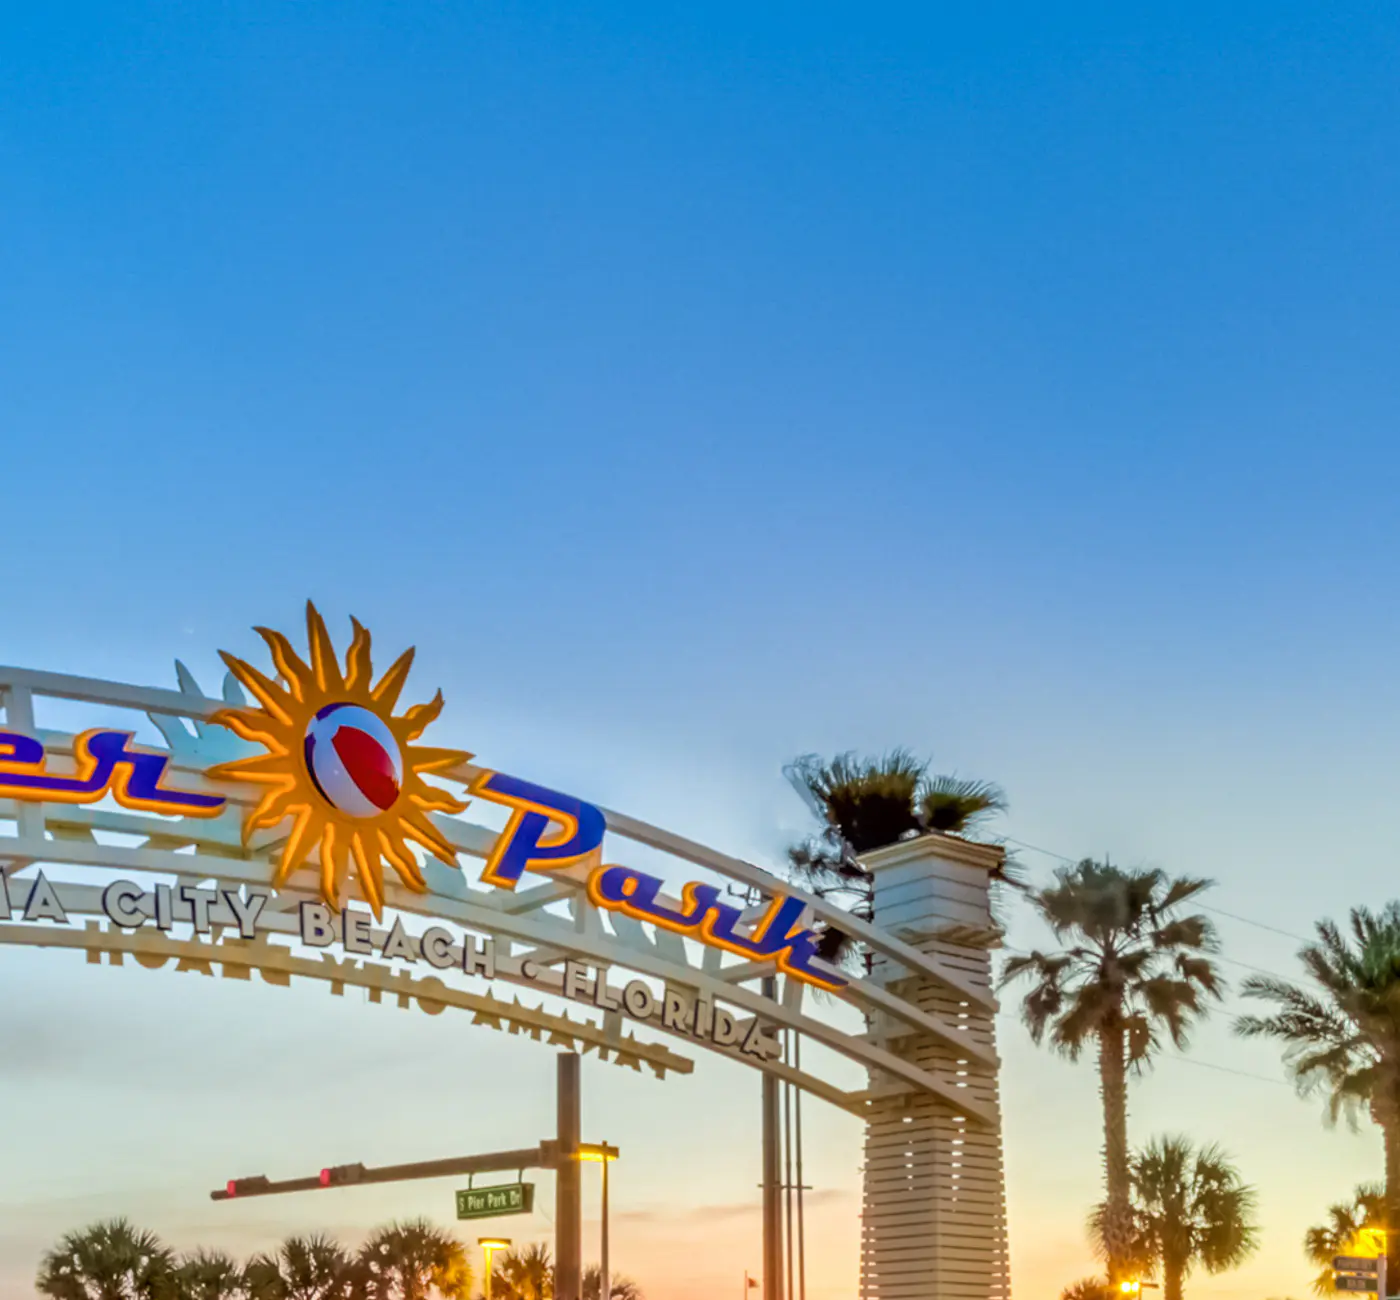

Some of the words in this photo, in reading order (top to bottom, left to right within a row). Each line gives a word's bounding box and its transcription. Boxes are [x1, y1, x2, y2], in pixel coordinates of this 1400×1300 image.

[102, 879, 268, 940] CITY
[300, 900, 496, 979] BEACH
[562, 957, 771, 1063] FLORIDA
[466, 768, 849, 991] Park
[459, 1196, 465, 1212] S
[467, 1195, 485, 1211] Pier
[487, 1192, 507, 1208] Park
[509, 1190, 520, 1206] Dr
